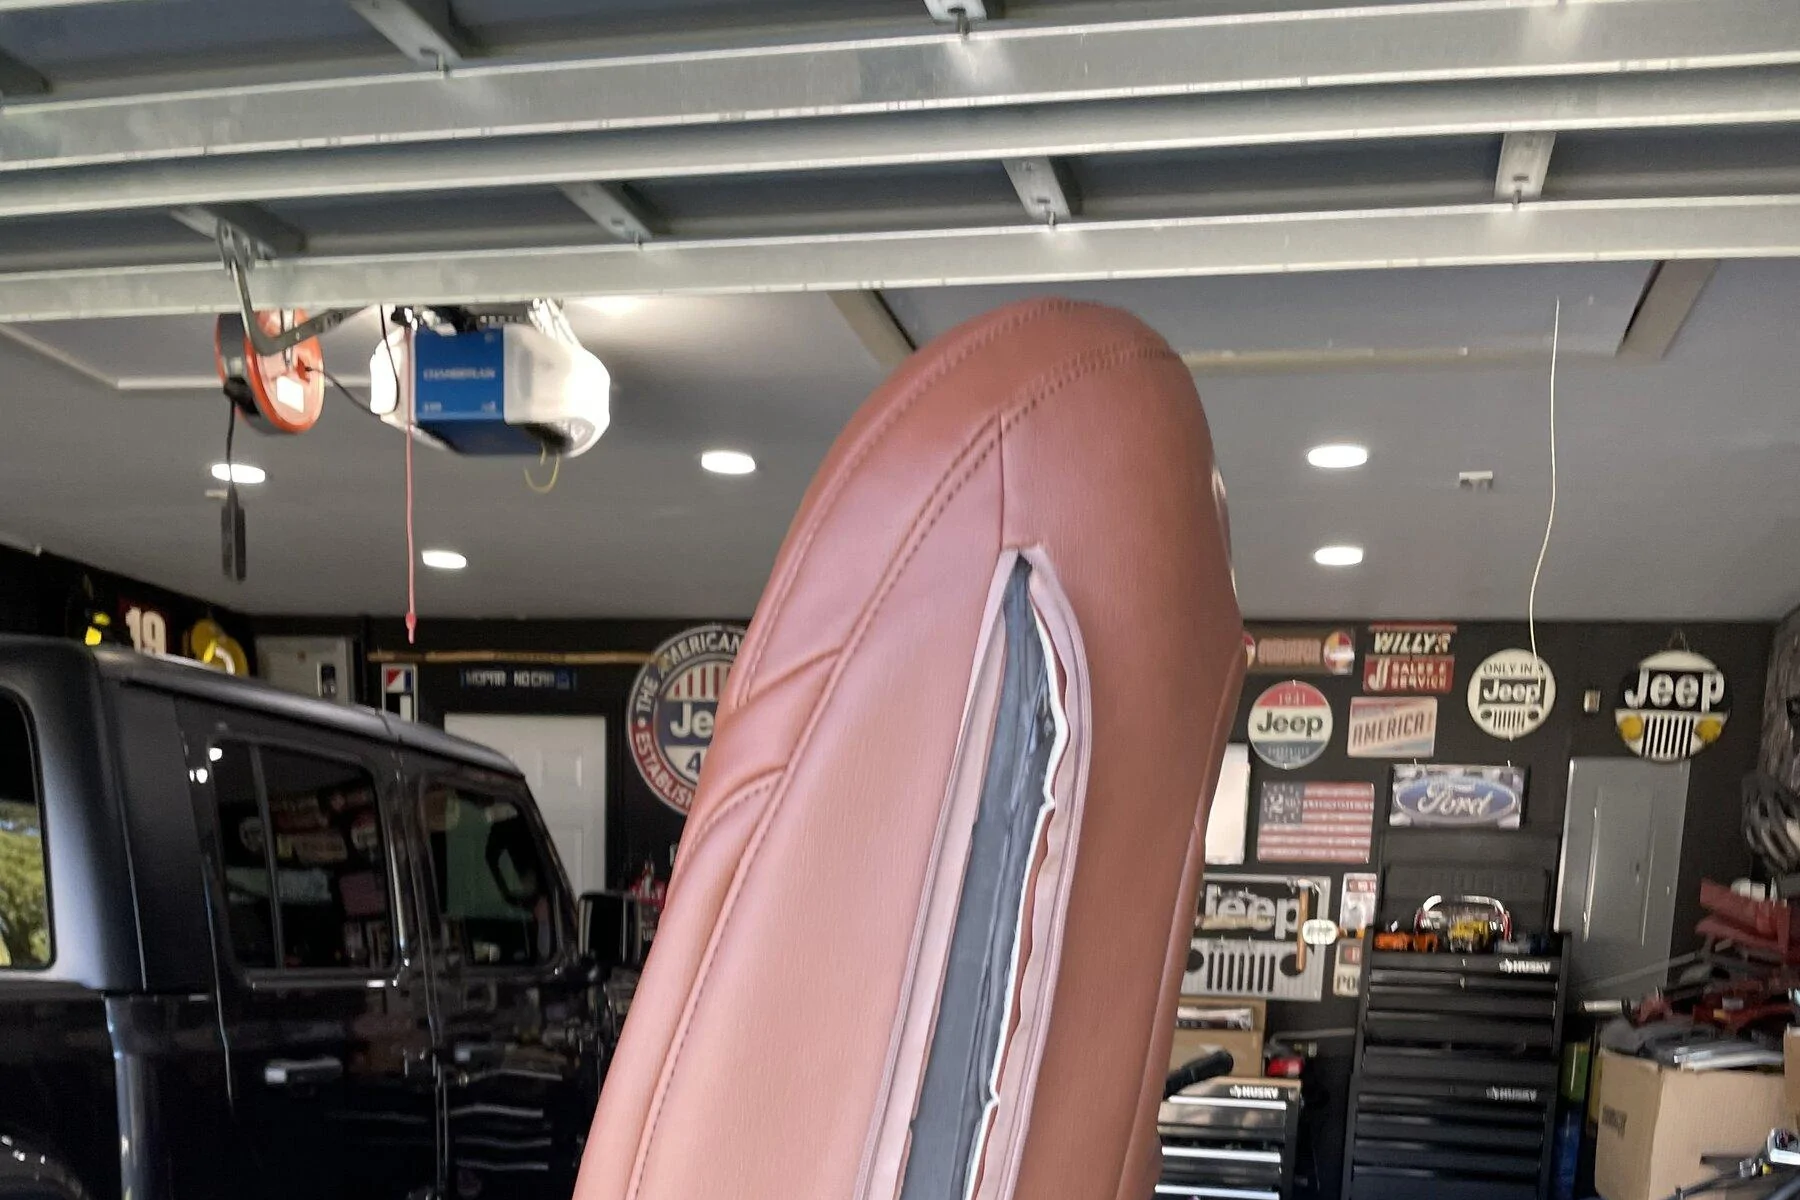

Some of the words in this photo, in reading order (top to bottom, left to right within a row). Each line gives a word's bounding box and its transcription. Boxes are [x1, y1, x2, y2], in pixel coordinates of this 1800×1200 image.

[1483, 662, 1515, 675] ONLY
[1520, 662, 1532, 675] IN
[1482, 678, 1541, 706] Jeep
[1624, 668, 1725, 713] Jeep
[1256, 709, 1323, 739] Jeep
[1417, 781, 1495, 816] Ford
